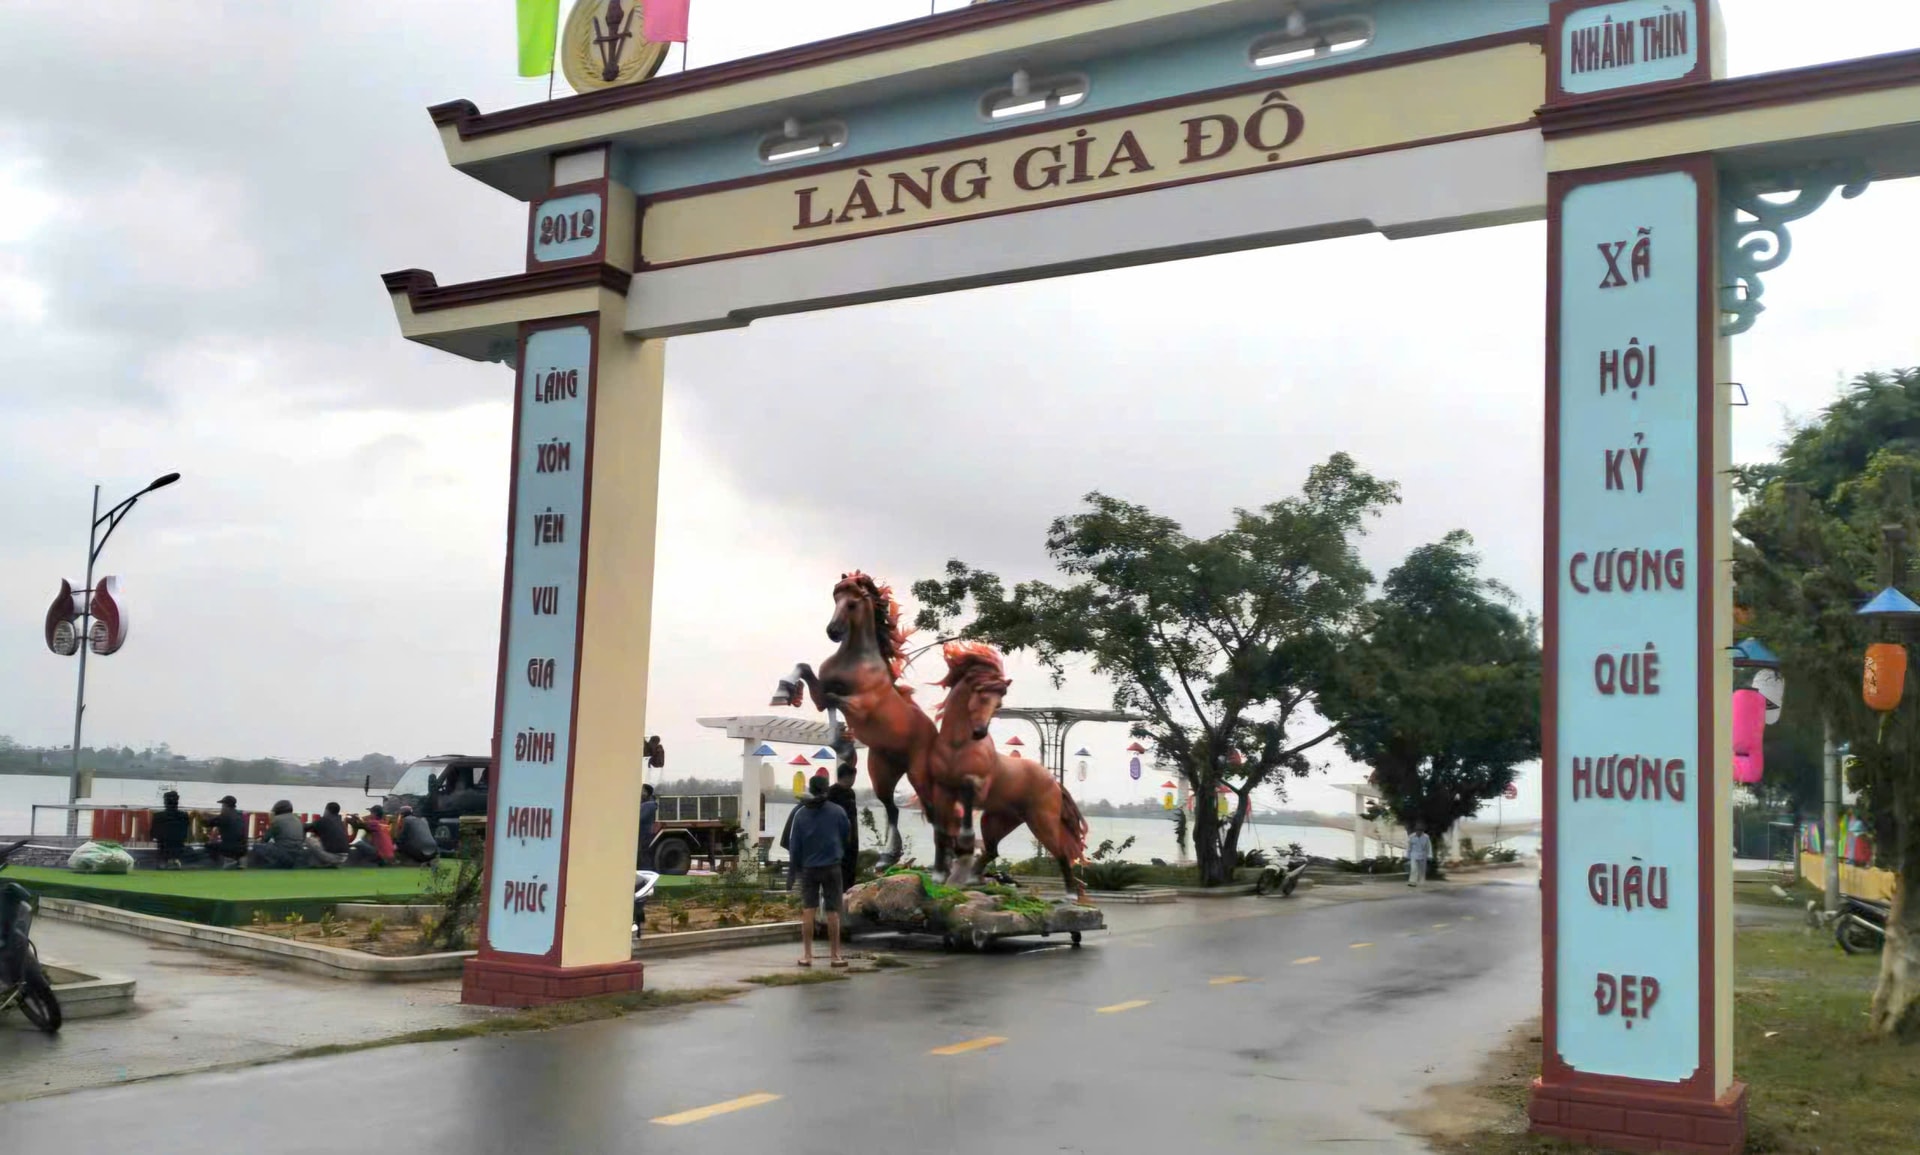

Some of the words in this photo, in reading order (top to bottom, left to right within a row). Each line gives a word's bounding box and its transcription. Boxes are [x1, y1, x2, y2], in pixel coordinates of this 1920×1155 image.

[1571, 14, 1635, 74] NHÂM
[1640, 4, 1687, 62] THÌN
[793, 158, 991, 230] LÀNG
[1179, 90, 1305, 165] ĐỘ
[539, 208, 594, 245] 2012
[1597, 226, 1652, 288] XÃ
[535, 366, 578, 403] LÀNG
[1600, 336, 1656, 400] HỘI
[536, 436, 571, 473] XÓM
[1605, 432, 1649, 493] KỶ
[534, 507, 564, 546] YÊN
[532, 586, 559, 615] VUI
[527, 658, 555, 691] GIA
[1595, 641, 1659, 695] QUÊ
[514, 726, 555, 765] ĐÌNH
[1572, 753, 1685, 802] HƯƠNG
[507, 806, 552, 846] HẠNH
[504, 875, 548, 914] PHÚC
[1588, 856, 1668, 912] GIÀU
[1594, 972, 1660, 1030] ĐẸP
